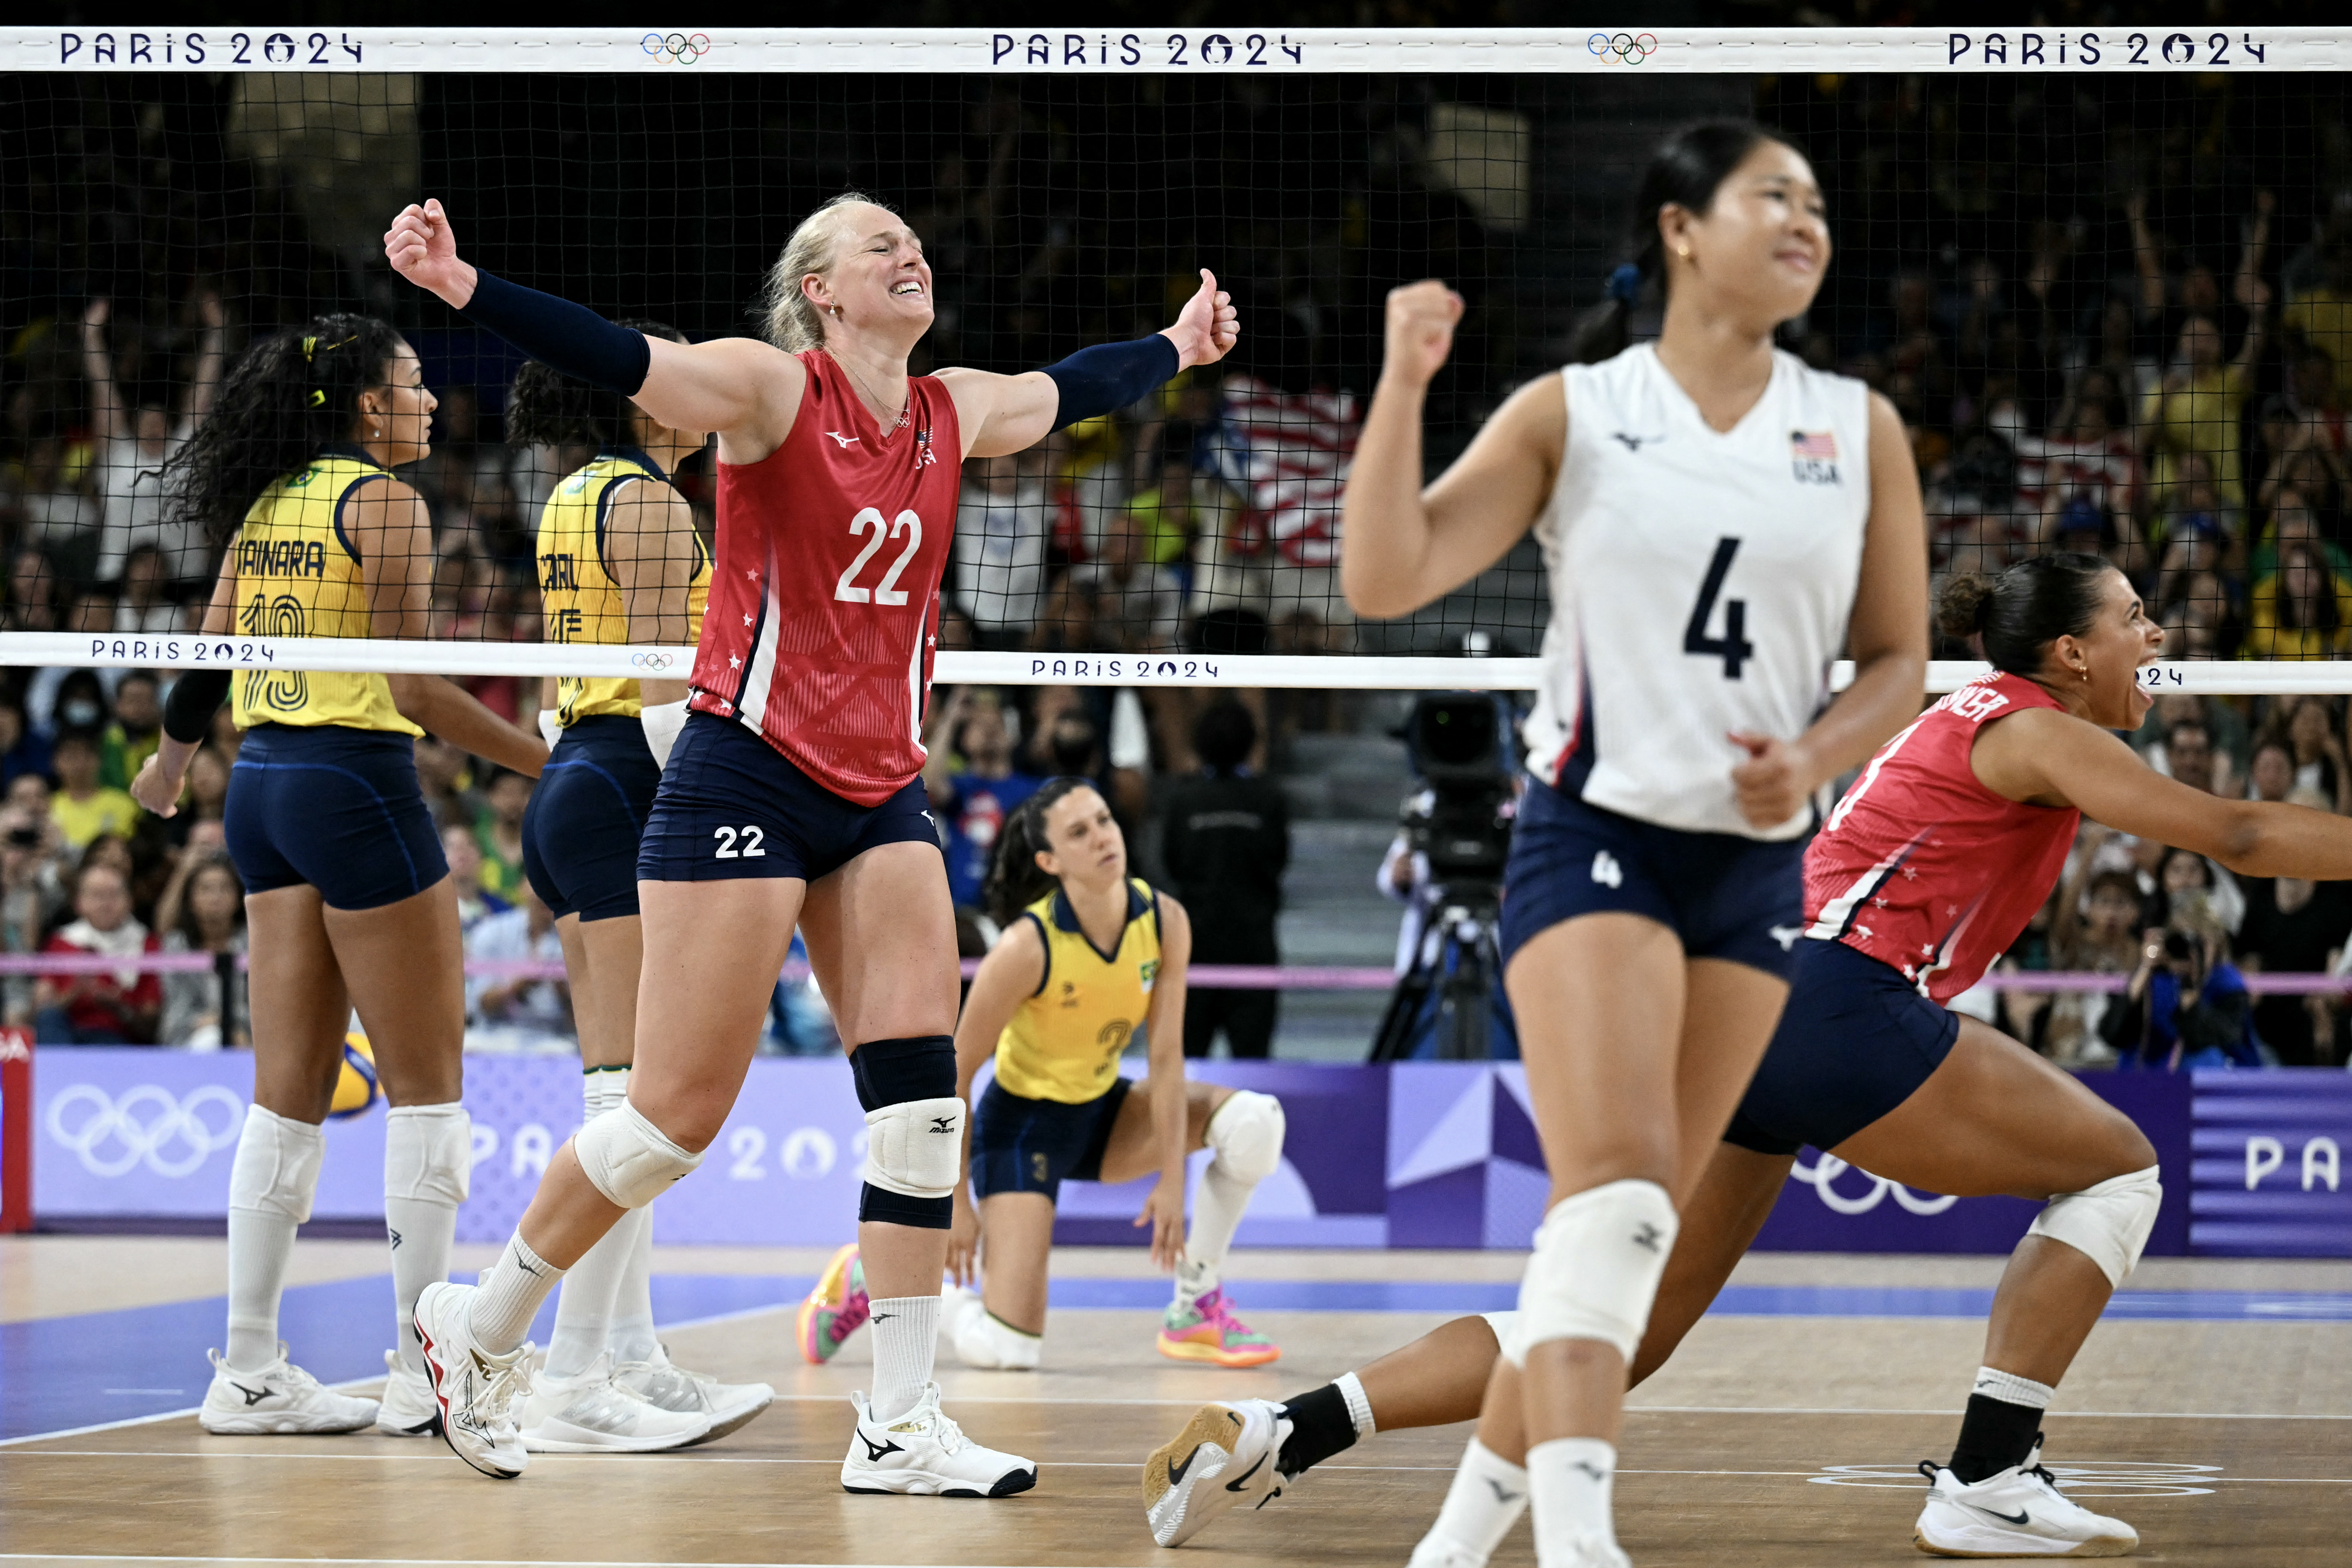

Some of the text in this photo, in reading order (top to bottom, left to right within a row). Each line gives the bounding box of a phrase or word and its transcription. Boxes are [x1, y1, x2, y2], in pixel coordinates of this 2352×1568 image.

[230, 32, 362, 64] 2024
[1167, 34, 1301, 65] 2024
[2127, 32, 2265, 65] 2024
[1793, 460, 1842, 486] USA
[834, 507, 923, 606] 22
[1683, 537, 1753, 679] 4
[195, 643, 273, 662] 2024
[1137, 661, 1218, 677] 2024
[714, 825, 766, 858] 22
[1591, 850, 1623, 888] 4
